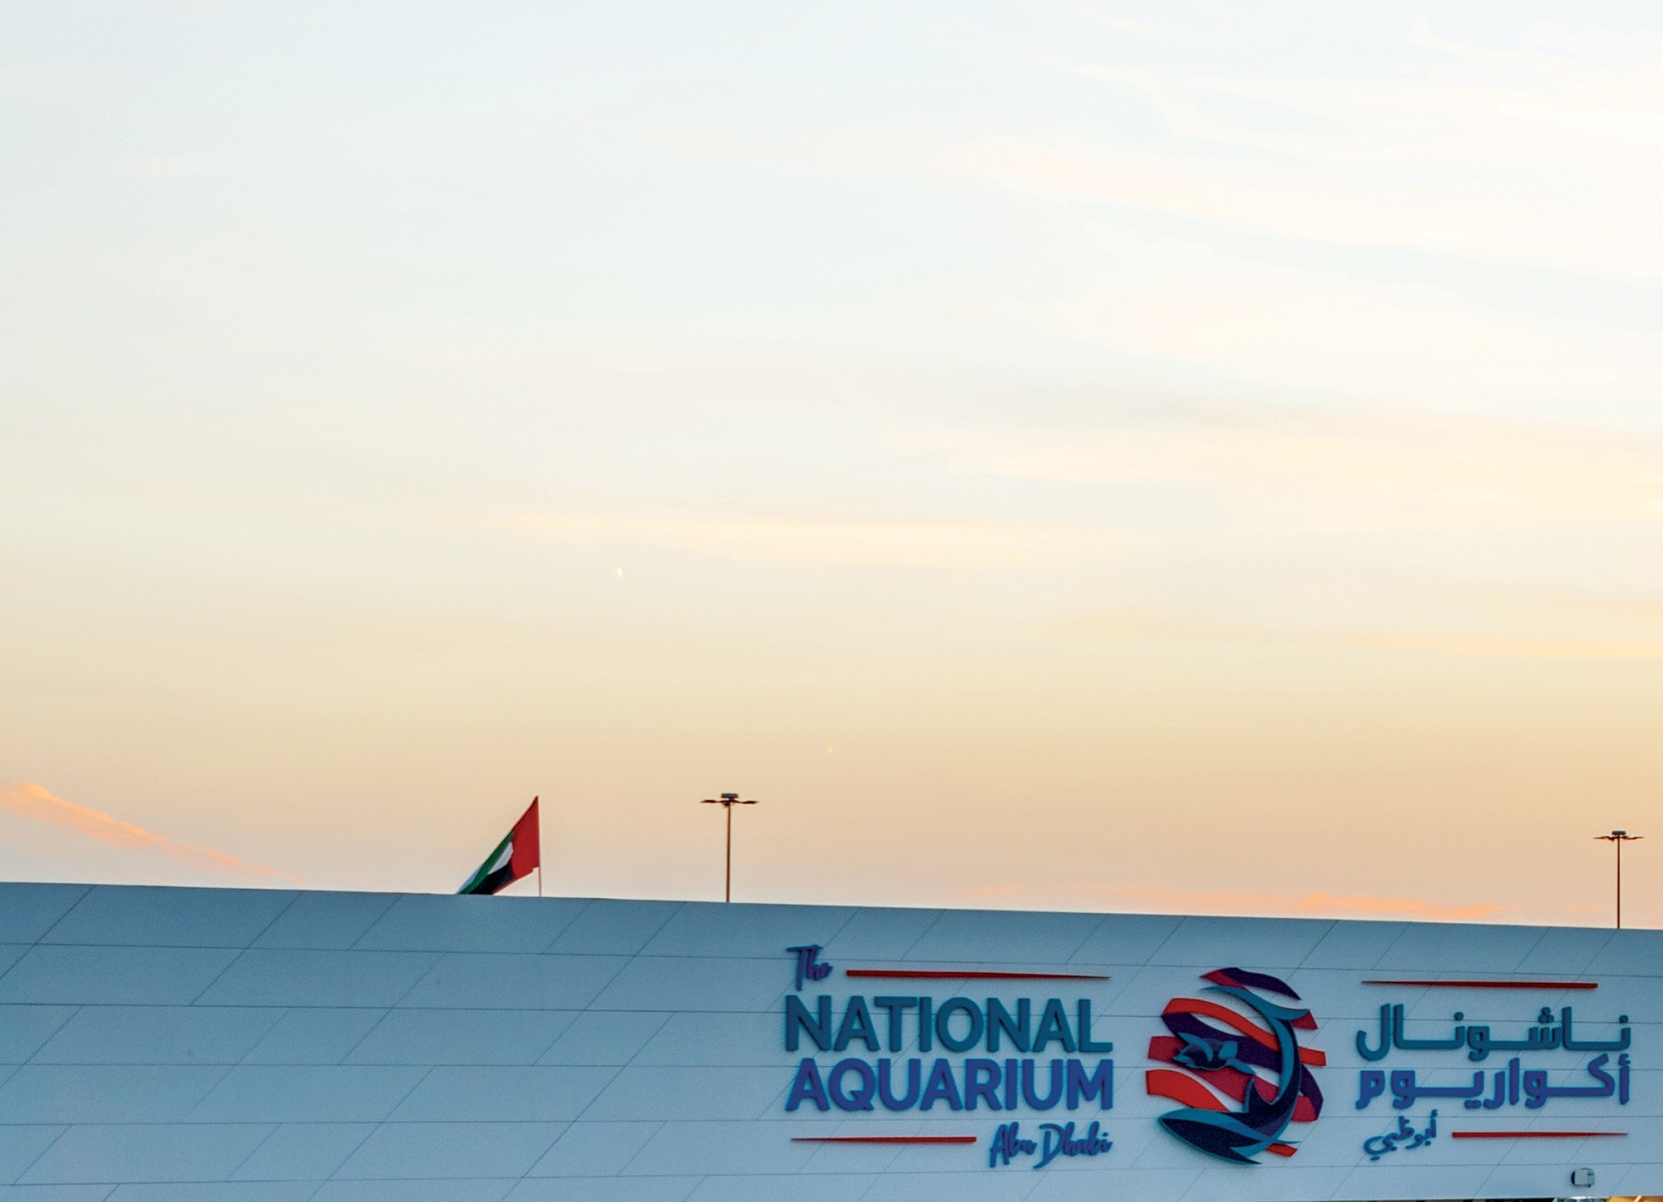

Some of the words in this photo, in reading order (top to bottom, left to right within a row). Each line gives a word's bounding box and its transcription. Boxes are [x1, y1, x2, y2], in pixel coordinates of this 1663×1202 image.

[786, 944, 834, 992] The
[785, 994, 1113, 1053] NATIONAL
[1356, 1003, 1632, 1061] ناشونال
[784, 1057, 1114, 1112] AQUARIUM
[1355, 1053, 1631, 1110] أكواريوم
[989, 1121, 1038, 1168] Abu
[1032, 1121, 1113, 1169] Dhabi
